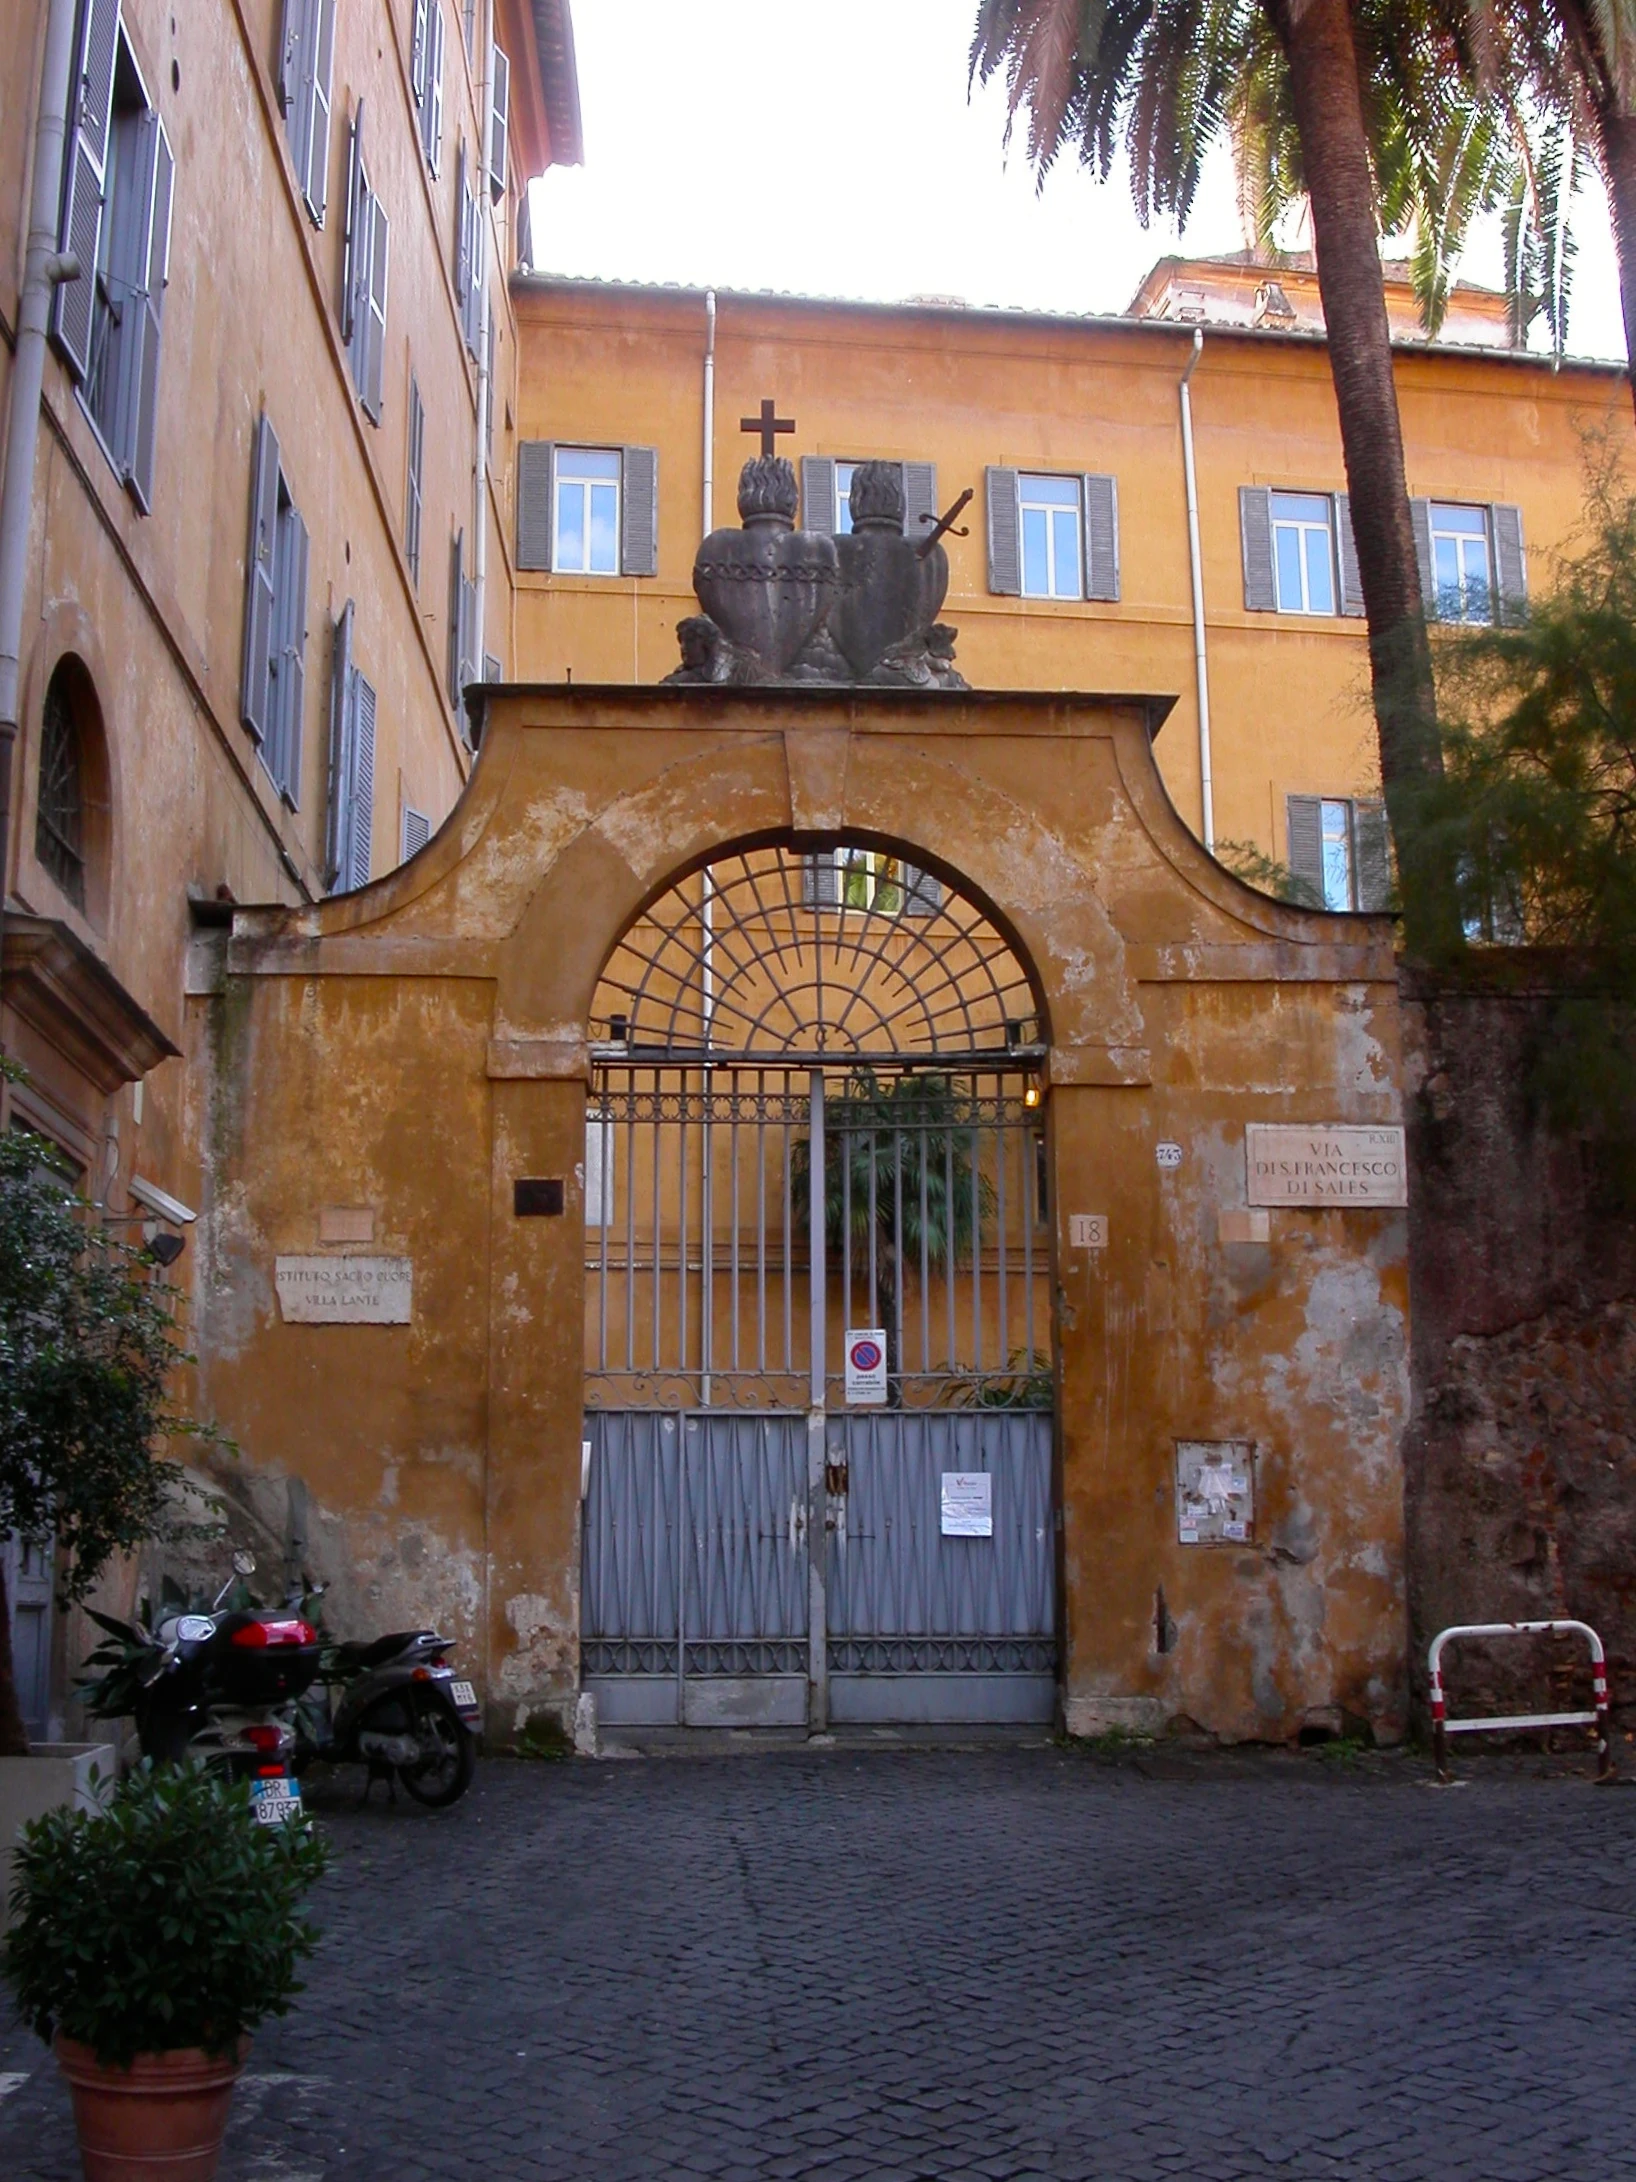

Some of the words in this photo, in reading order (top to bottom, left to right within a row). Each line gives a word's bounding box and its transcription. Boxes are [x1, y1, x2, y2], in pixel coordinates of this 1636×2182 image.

[1309, 1142, 1343, 1157] VIA
[1256, 1162, 1275, 1175] DI
[1287, 1180, 1307, 1194] DI
[1314, 1180, 1369, 1194] SALES
[1079, 1220, 1101, 1243] 18
[277, 1271, 331, 1282] ISTITUTO
[335, 1271, 372, 1282] SACRO
[376, 1271, 412, 1282] CUORE
[305, 1295, 337, 1306] VILLA
[341, 1295, 380, 1306] LANTE
